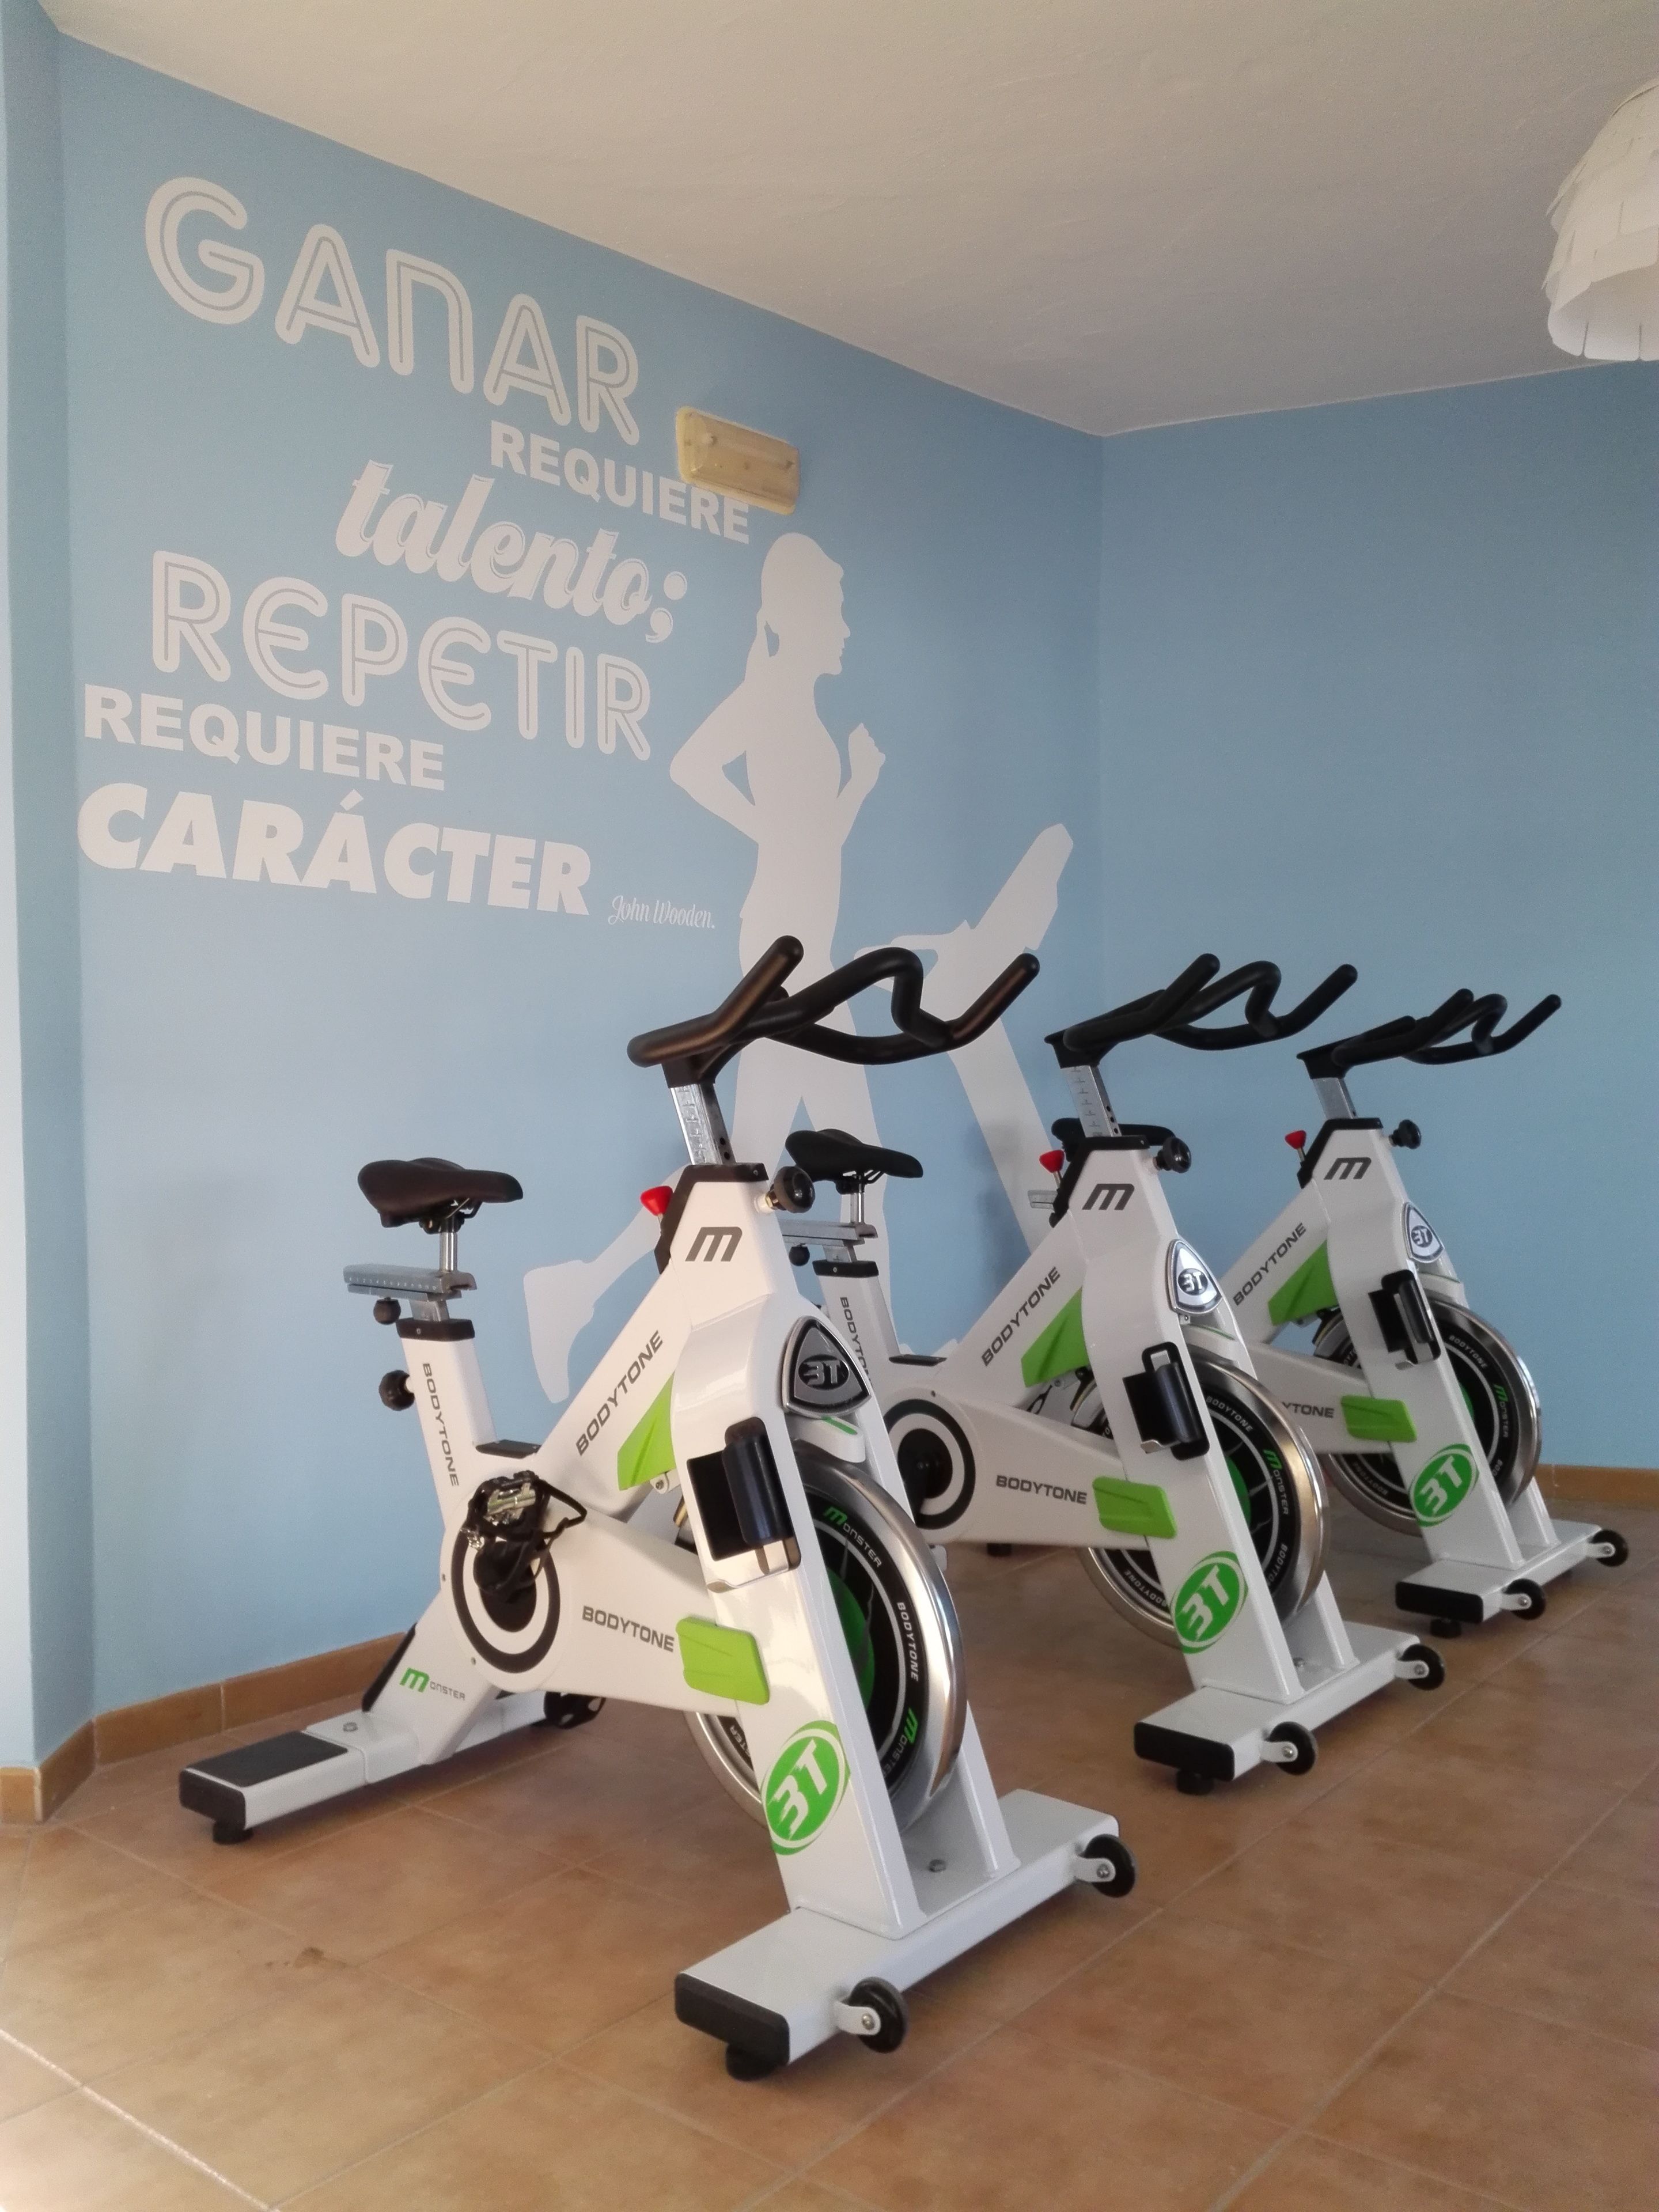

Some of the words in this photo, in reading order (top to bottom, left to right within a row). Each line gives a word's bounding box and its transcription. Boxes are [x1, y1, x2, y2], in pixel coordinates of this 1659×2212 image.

[145, 177, 641, 445] GANAR
[491, 419, 749, 544] REQUIERE
[152, 550, 651, 760] REPETIR
[84, 683, 445, 790] REQUIERE
[77, 782, 591, 915] CARÁCTER
[608, 895, 650, 925] John
[1233, 1222, 1306, 1306] BODYTONE
[981, 1266, 1061, 1367] BODYTONE
[1449, 1335, 1488, 1369] BODYTONE
[423, 1362, 459, 1487] BODYTONE
[576, 1330, 664, 1457] BODYTONE
[1205, 1396, 1253, 1433] BODYTONE
[995, 1475, 1087, 1505] BODYTONE
[582, 1606, 675, 1653] BODYTONE
[896, 1602, 919, 1682] BODYTONE
